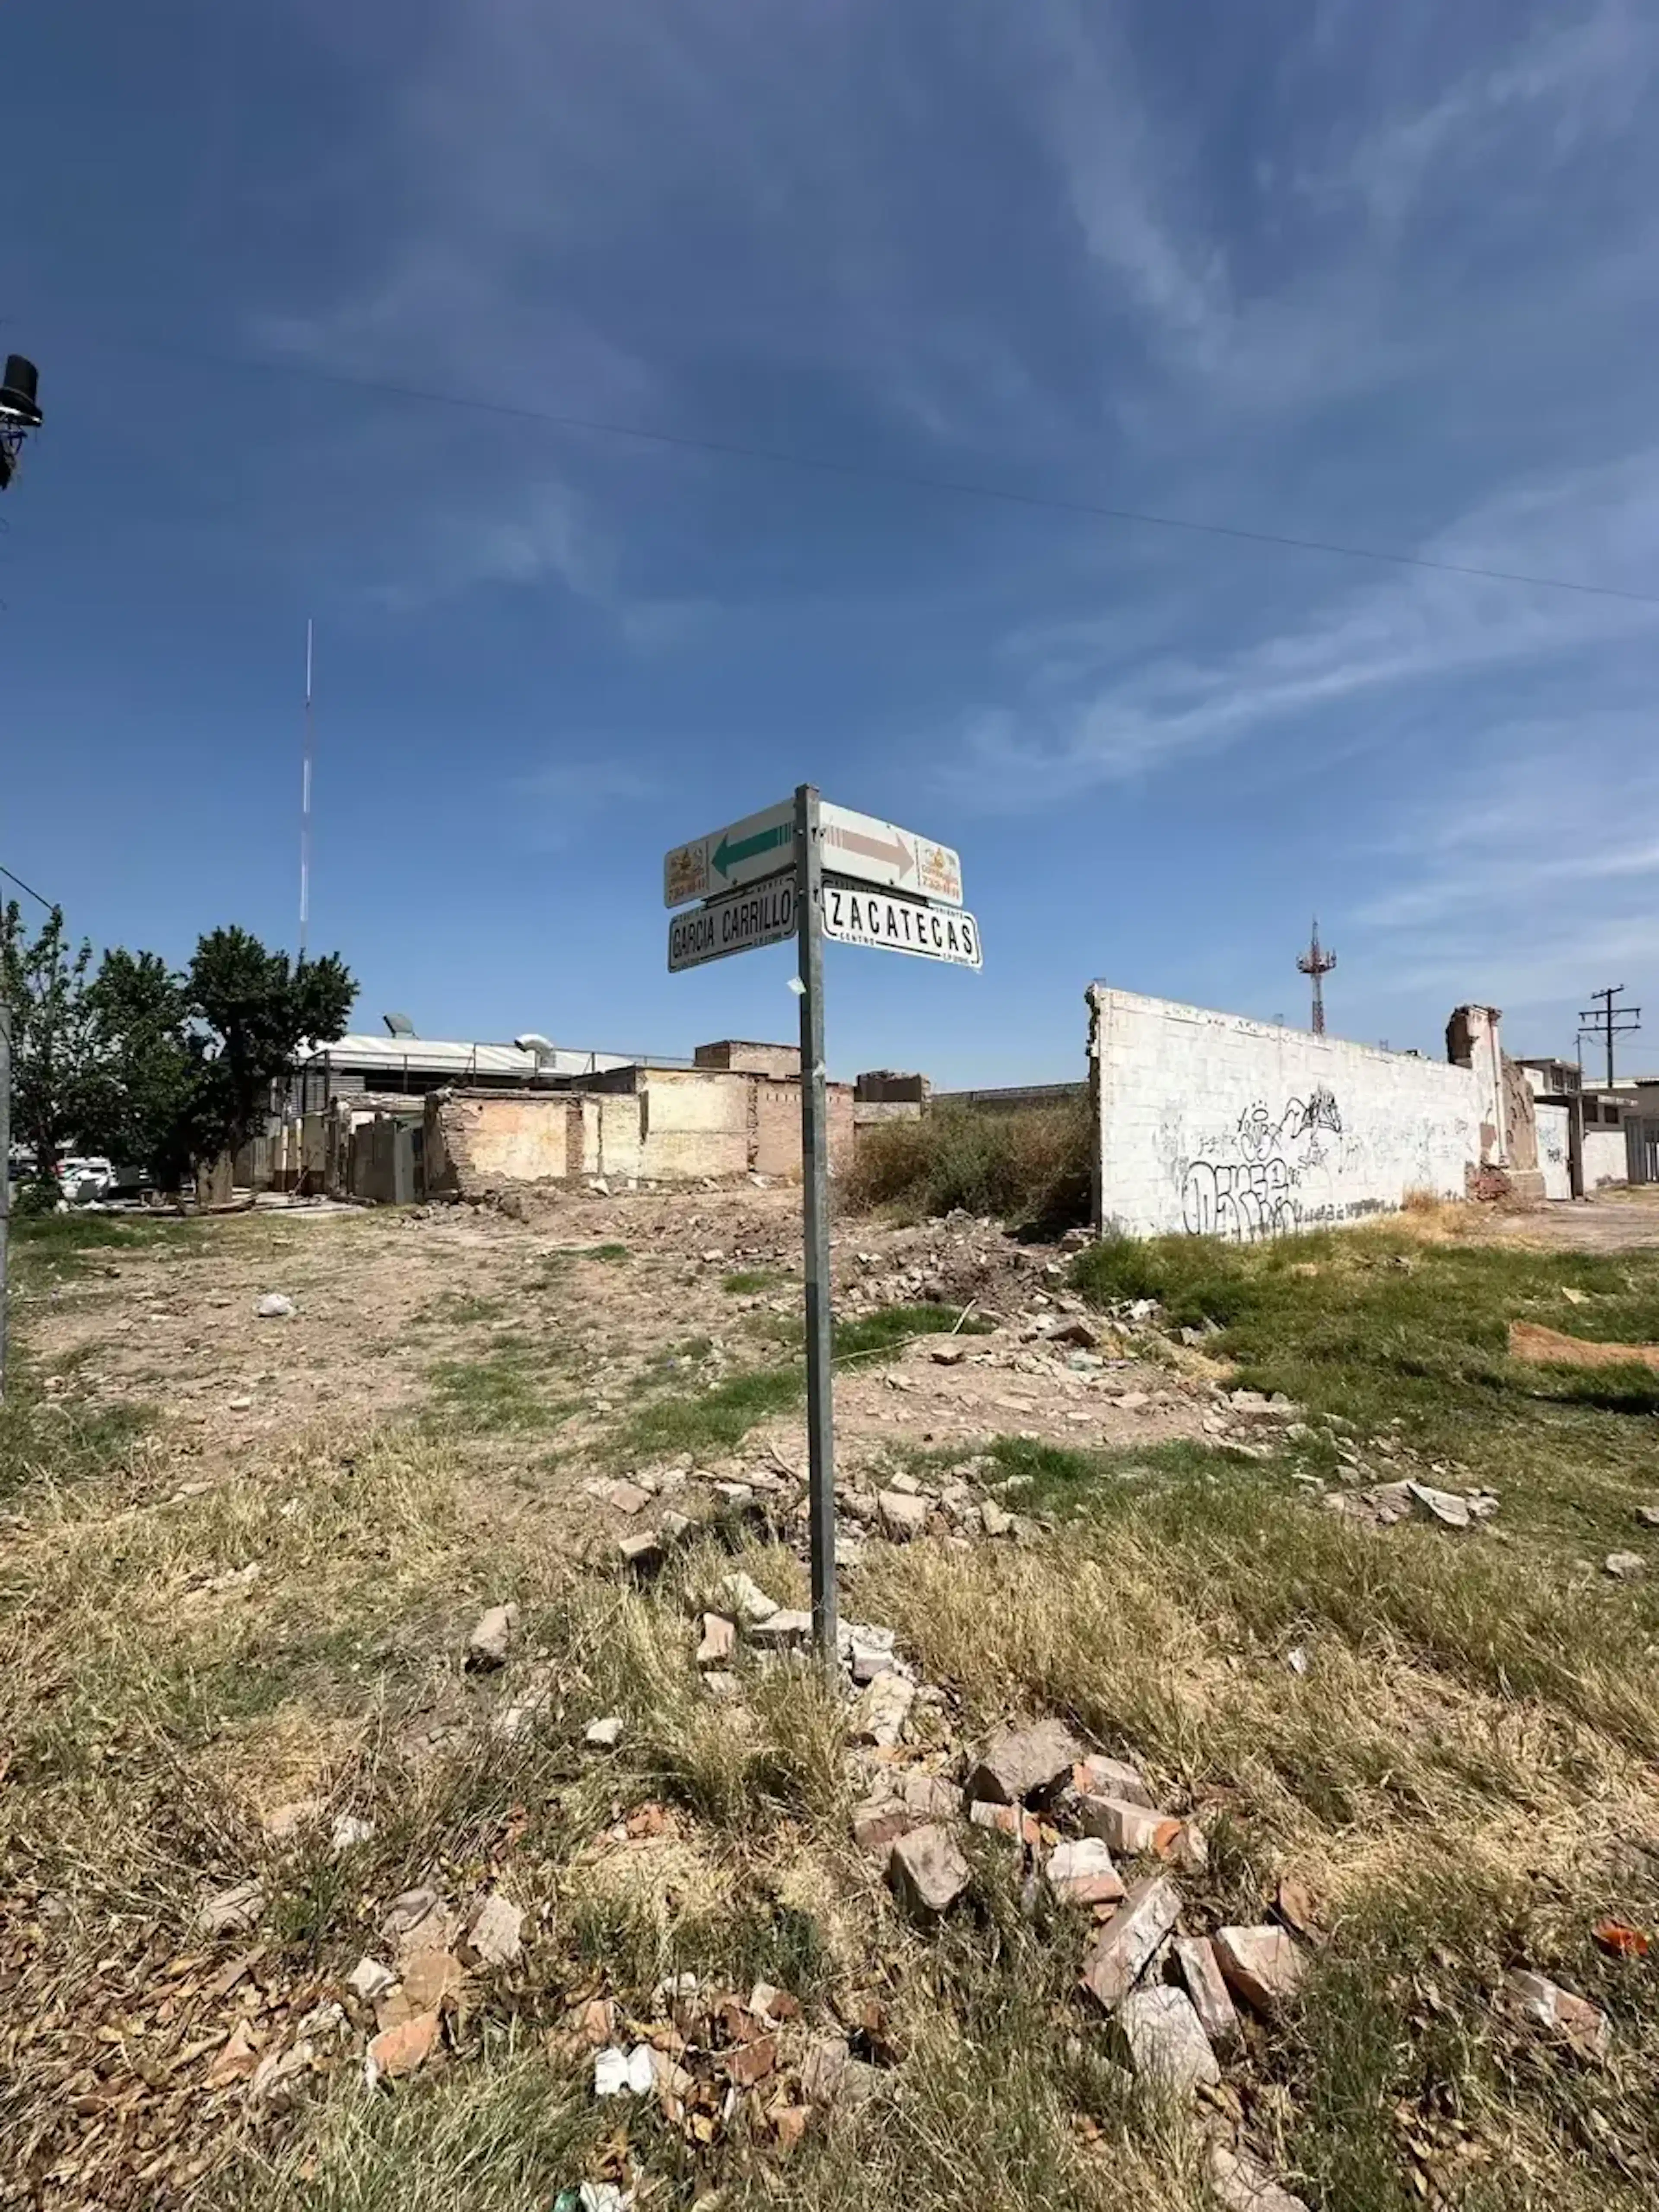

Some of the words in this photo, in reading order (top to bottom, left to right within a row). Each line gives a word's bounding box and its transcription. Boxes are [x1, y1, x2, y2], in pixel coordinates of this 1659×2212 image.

[673, 916, 714, 958] GARCIA
[722, 889, 791, 943] CARRILLO
[831, 891, 972, 954] ZACATECAS
[840, 932, 874, 946] CENTRO
